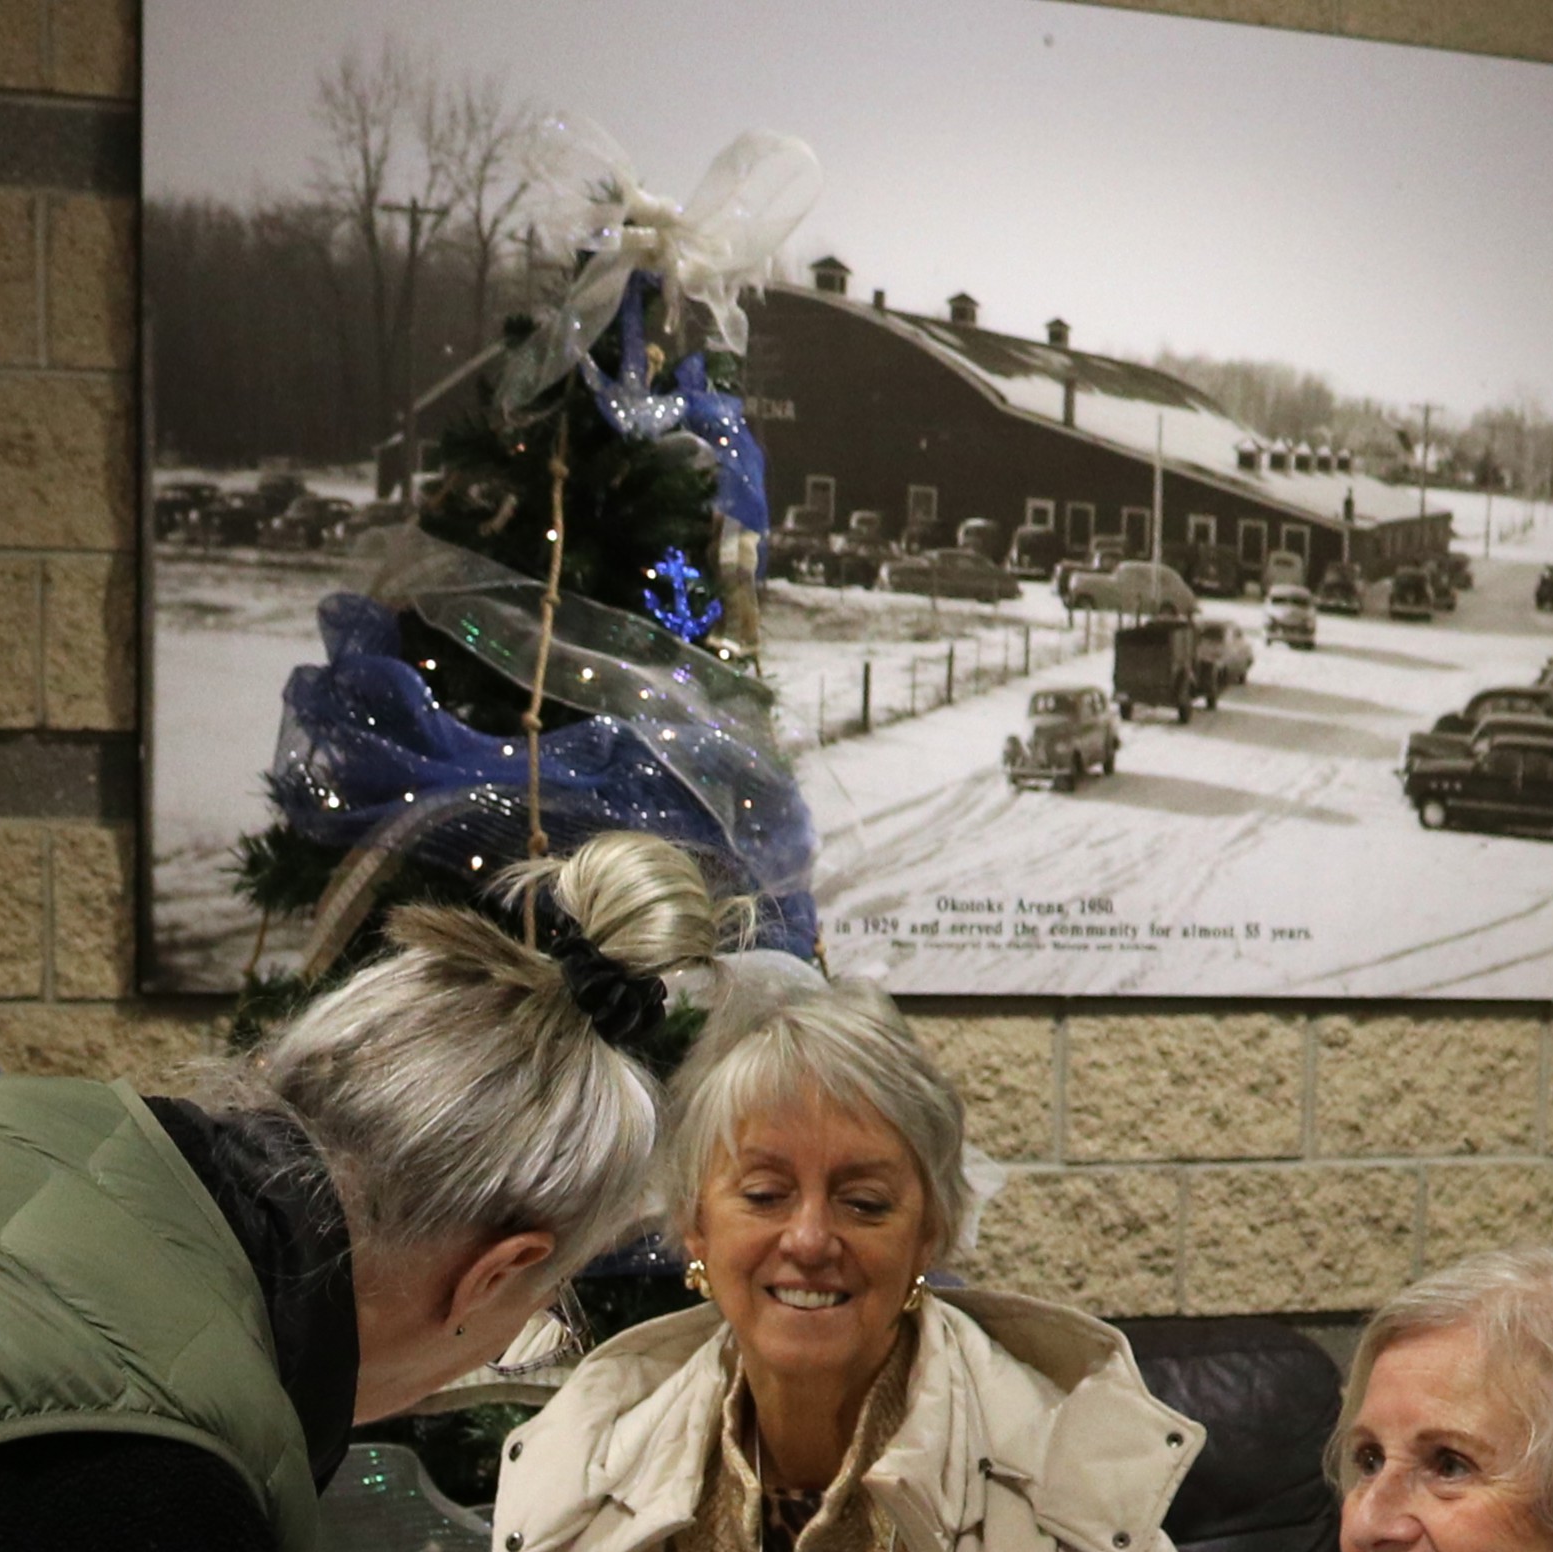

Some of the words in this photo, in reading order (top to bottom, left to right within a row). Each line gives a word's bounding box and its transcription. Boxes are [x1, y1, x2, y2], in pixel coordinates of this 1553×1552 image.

[936, 898, 1003, 914] Okotoks
[835, 919, 851, 934] in
[863, 918, 898, 934] 1929
[910, 920, 940, 935] and
[950, 921, 1003, 936] served
[1014, 921, 1039, 937] the
[1049, 922, 1139, 939] community
[1149, 923, 1172, 937] for
[1182, 924, 1234, 938] almost
